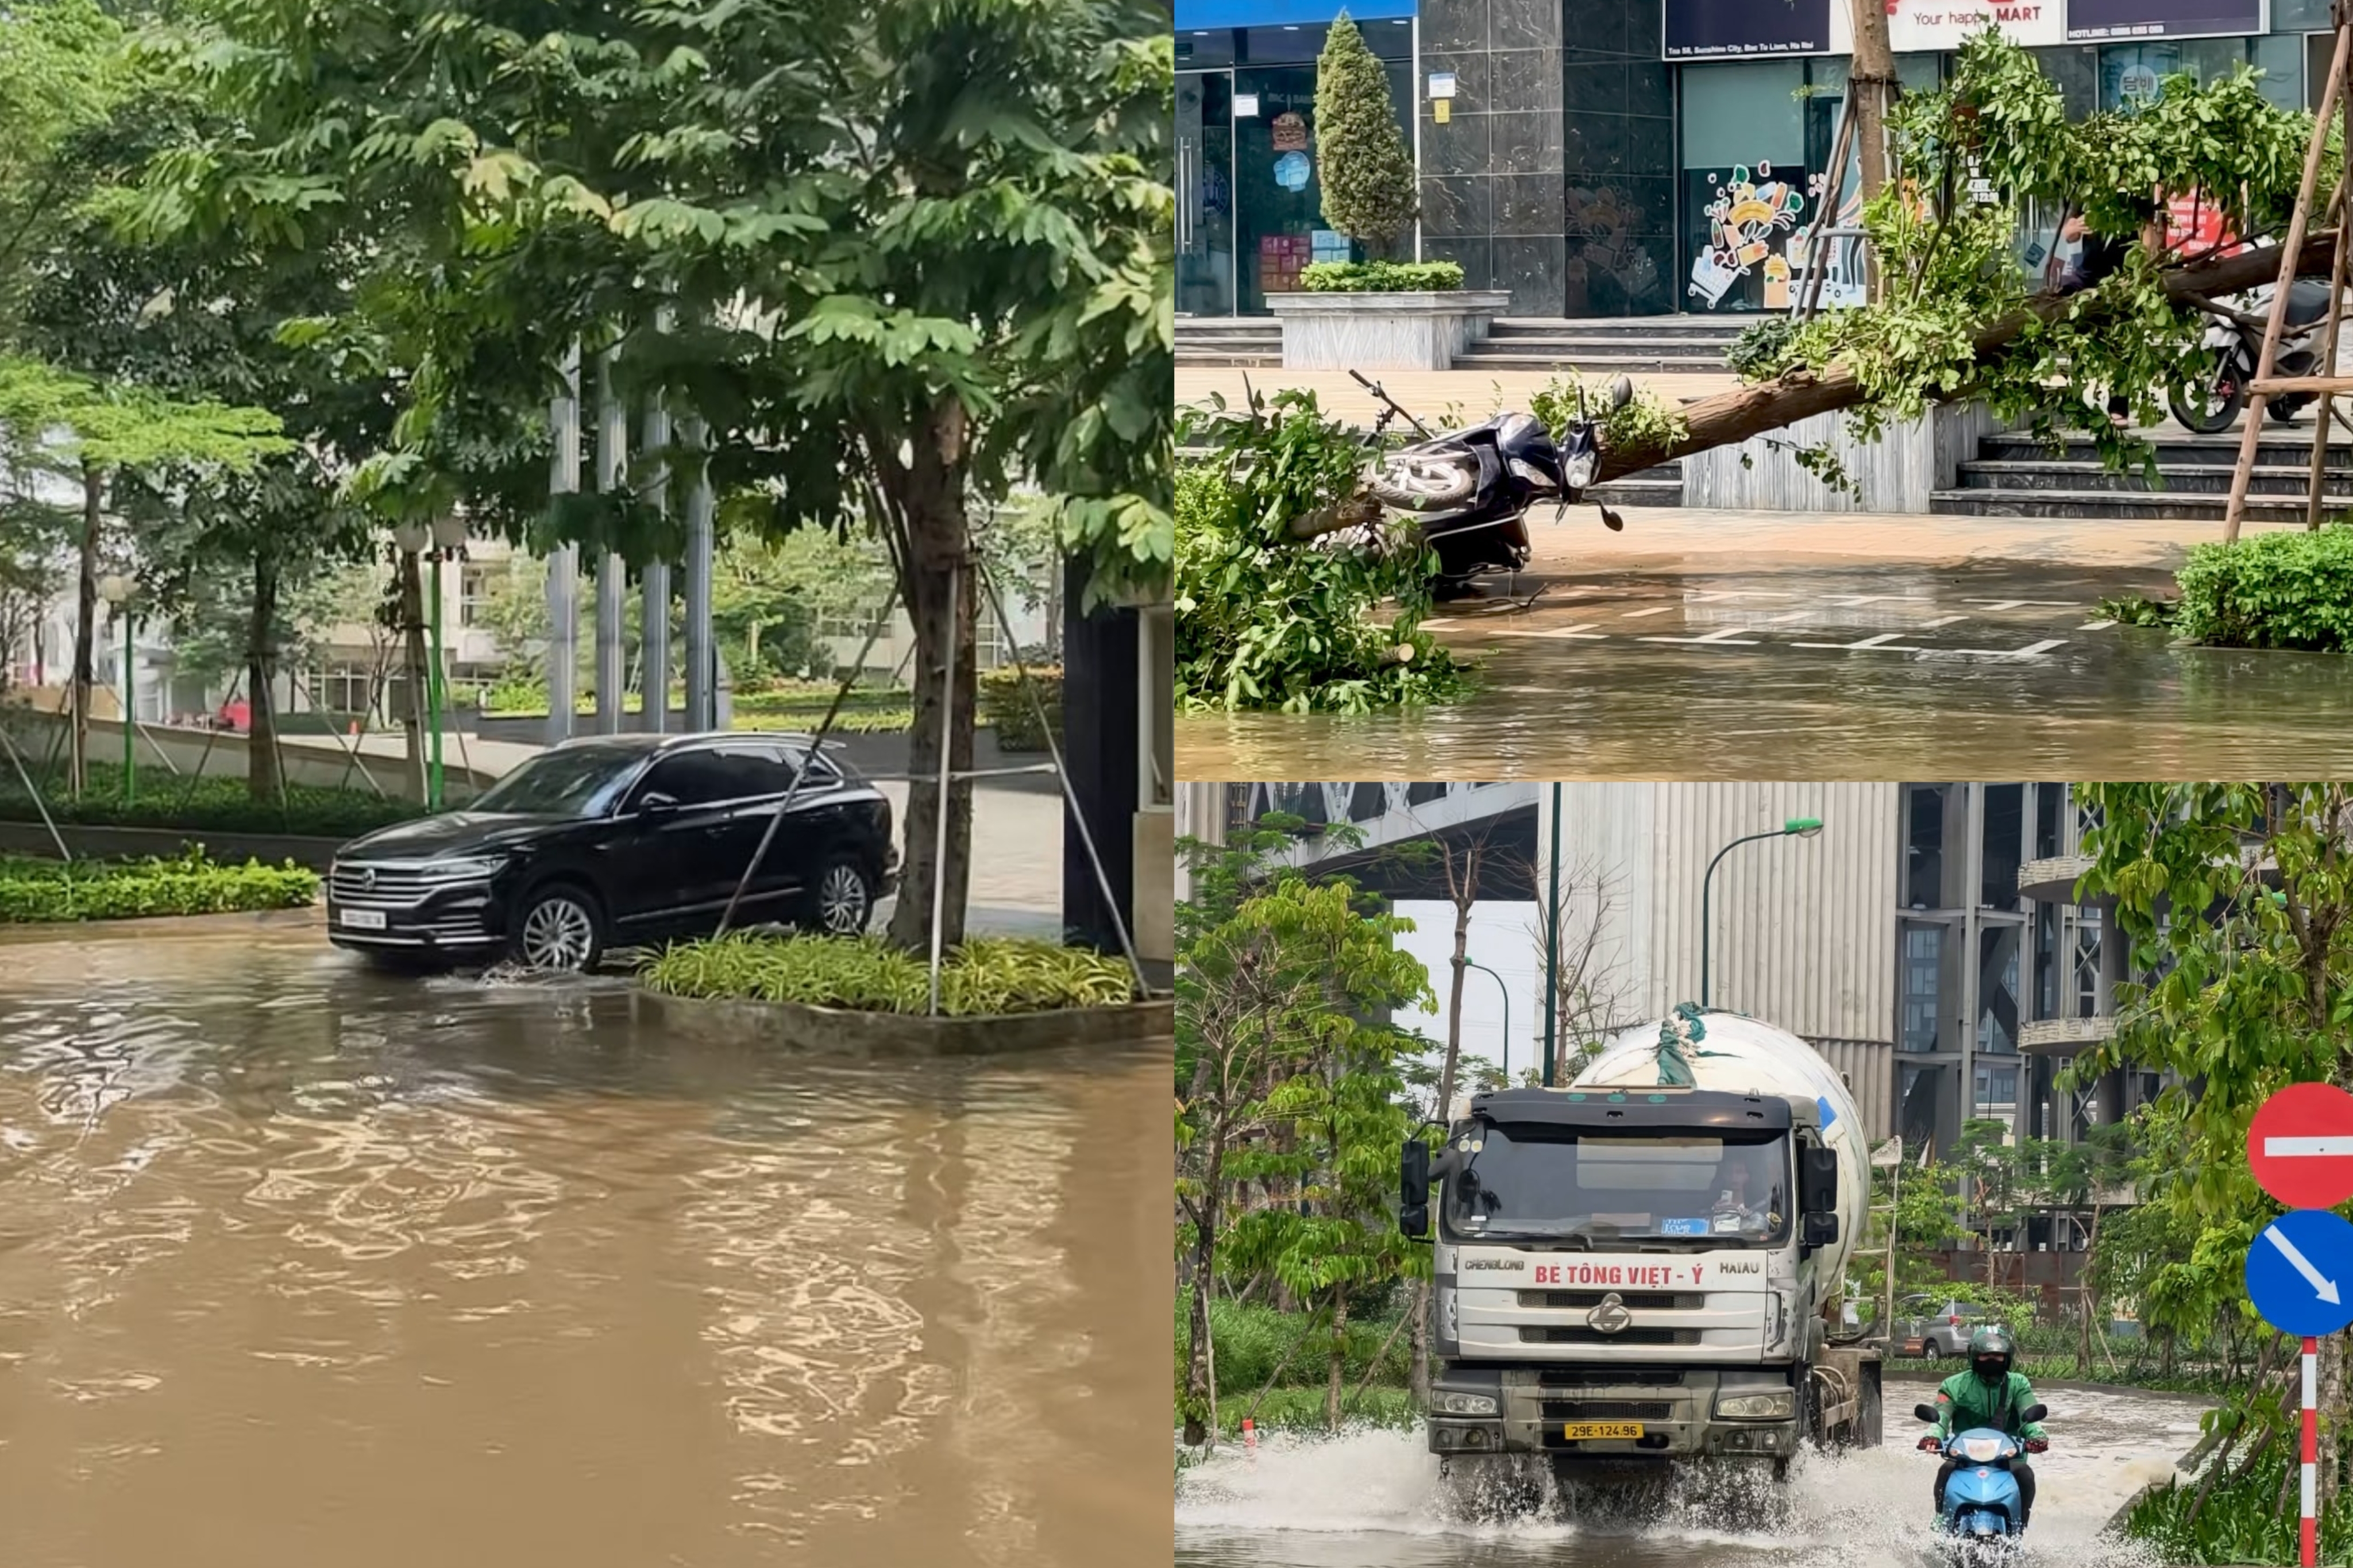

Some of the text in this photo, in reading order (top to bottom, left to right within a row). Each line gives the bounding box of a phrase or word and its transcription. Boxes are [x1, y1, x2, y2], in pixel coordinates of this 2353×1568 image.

[1914, 6, 2041, 26] Your happ MART
[2123, 76, 2154, 92] 담배
[1567, 1263, 1621, 1284] TÔNG
[1692, 1263, 1703, 1284] Ý
[1572, 1426, 1637, 1436] 29E-124.96
